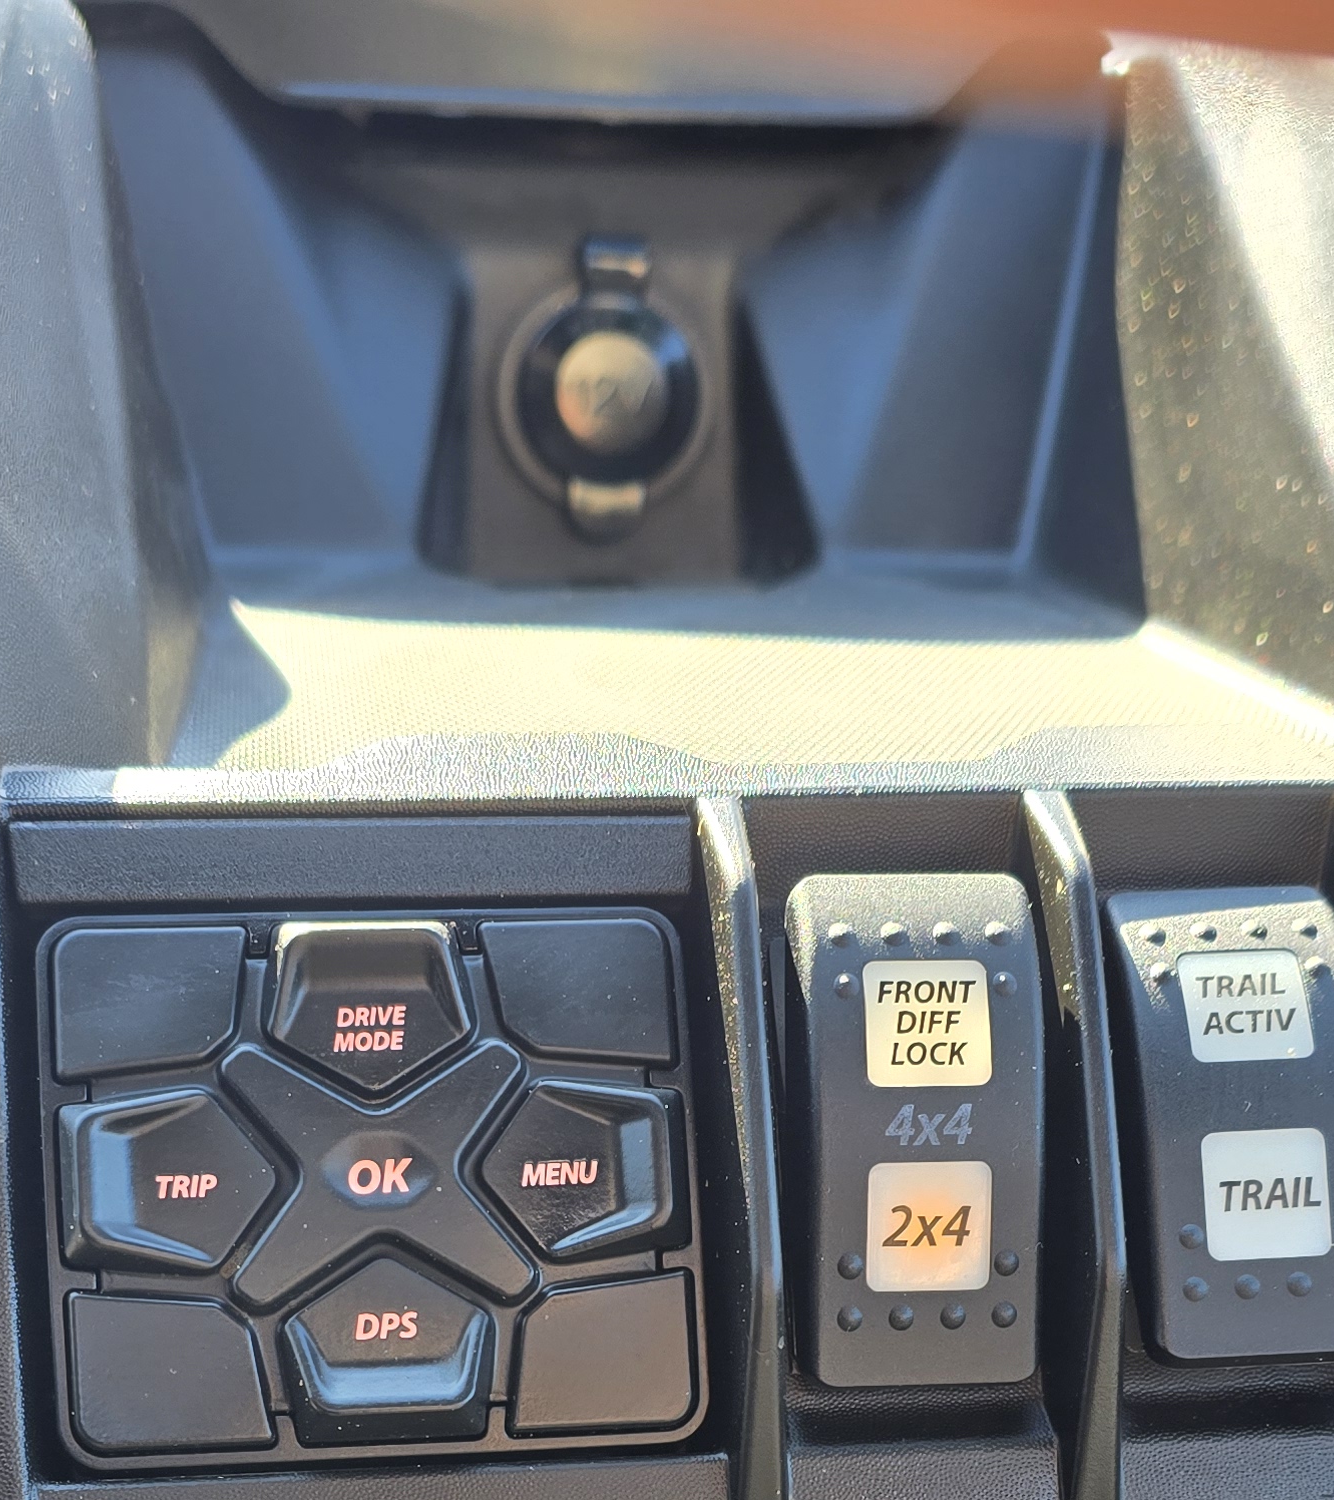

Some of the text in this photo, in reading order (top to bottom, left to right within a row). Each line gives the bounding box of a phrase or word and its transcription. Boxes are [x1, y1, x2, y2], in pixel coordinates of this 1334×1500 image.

[877, 980, 977, 1004] FRONT
[1195, 972, 1286, 999] TRAIL
[336, 1004, 407, 1028] DRIVE
[896, 1010, 962, 1035] DIFF
[1202, 1007, 1297, 1036] ACTIV
[333, 1030, 405, 1053] MODE
[890, 1041, 968, 1066] LOCK
[884, 1103, 973, 1146] 4x4
[155, 1173, 218, 1200] TRIP
[347, 1157, 413, 1195] OK
[521, 1159, 599, 1188] MENU
[1218, 1176, 1322, 1213] TRAIL
[881, 1204, 972, 1247] 2x4
[355, 1311, 418, 1341] DPS
